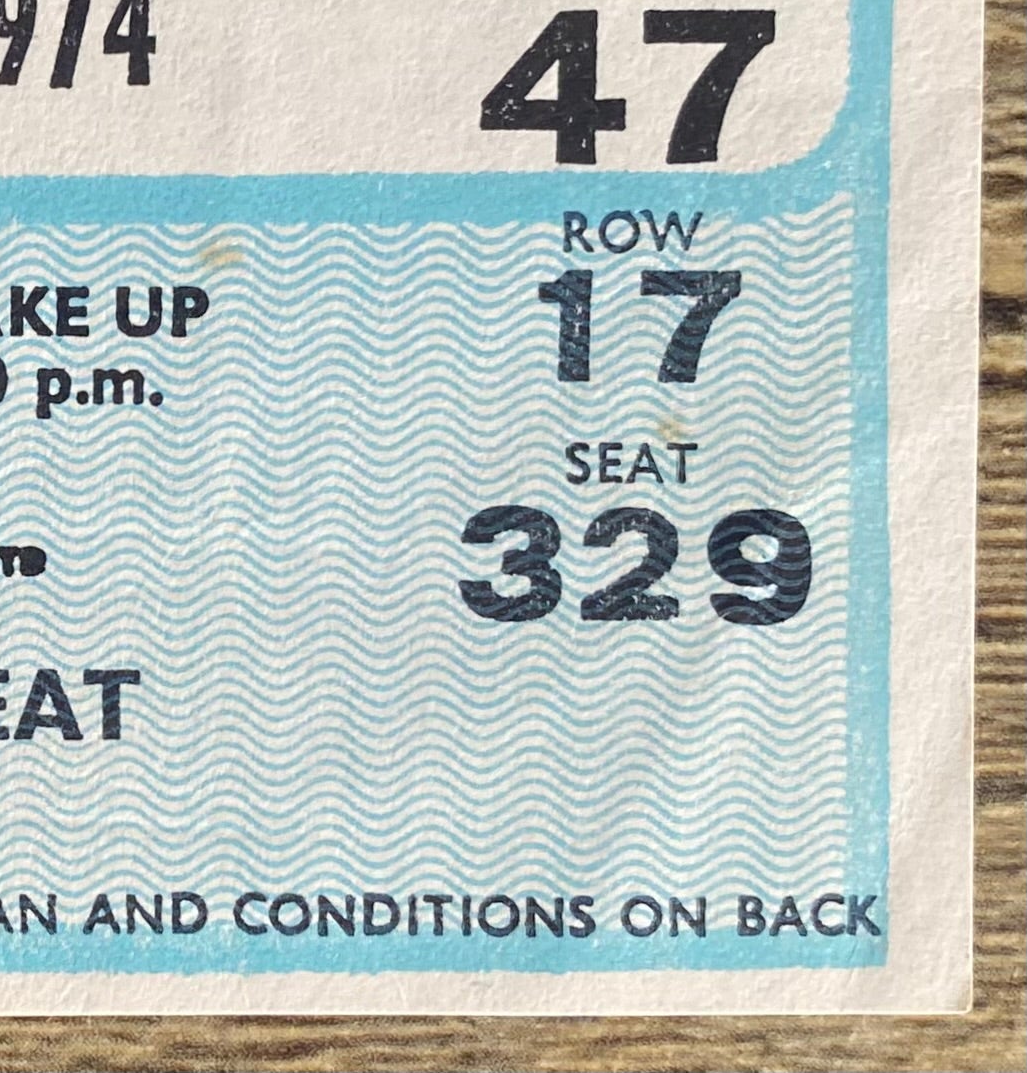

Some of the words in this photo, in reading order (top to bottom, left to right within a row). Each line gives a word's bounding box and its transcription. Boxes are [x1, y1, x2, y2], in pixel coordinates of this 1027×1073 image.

[480, 10, 776, 164] 47
[564, 210, 702, 253] ROW
[116, 286, 209, 337] UP
[539, 270, 741, 382] 17
[36, 368, 163, 419] p.m.
[566, 443, 698, 484] SEAT
[459, 505, 812, 625] 329
[84, 892, 207, 934] AND
[234, 892, 595, 937] CONDITIONS
[622, 898, 706, 936] ON
[739, 895, 880, 936] BACK
